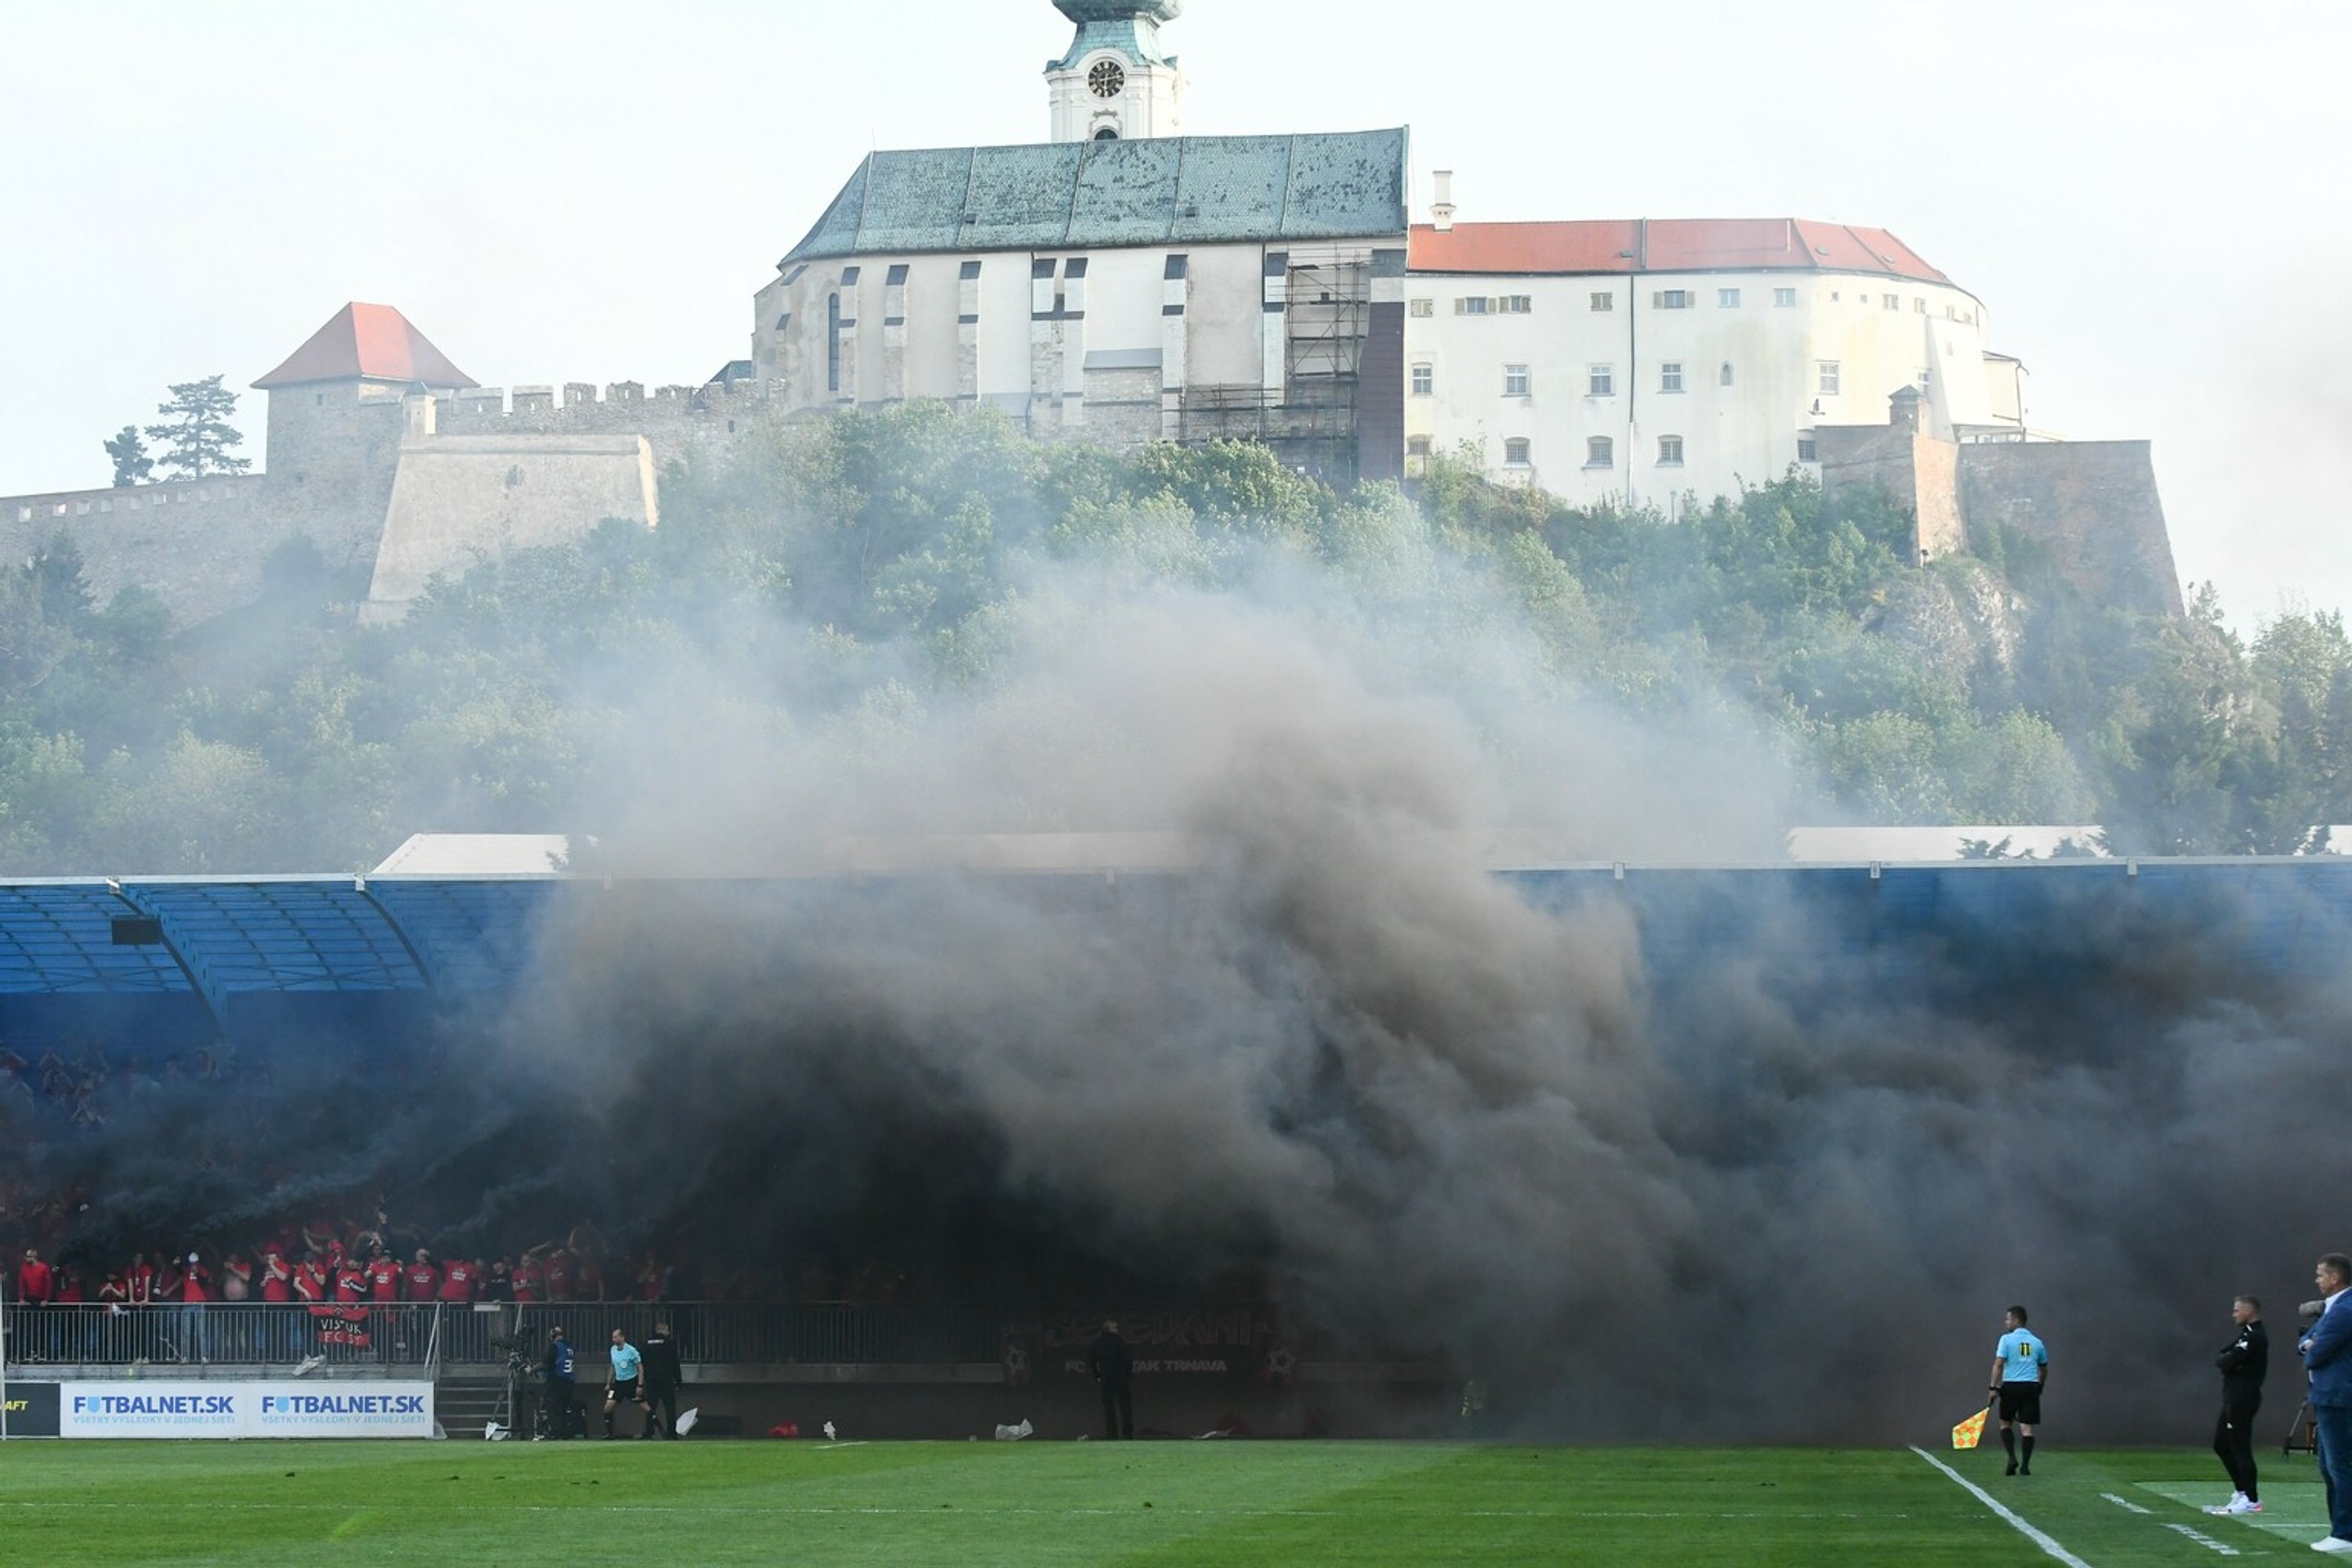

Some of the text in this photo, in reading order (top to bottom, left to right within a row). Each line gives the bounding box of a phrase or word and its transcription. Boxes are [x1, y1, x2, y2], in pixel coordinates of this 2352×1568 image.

[324, 1330, 343, 1343] FC
[1065, 1361, 1085, 1372] FC
[1164, 1361, 1227, 1372] TRNAVA
[1, 1400, 29, 1411] AFT
